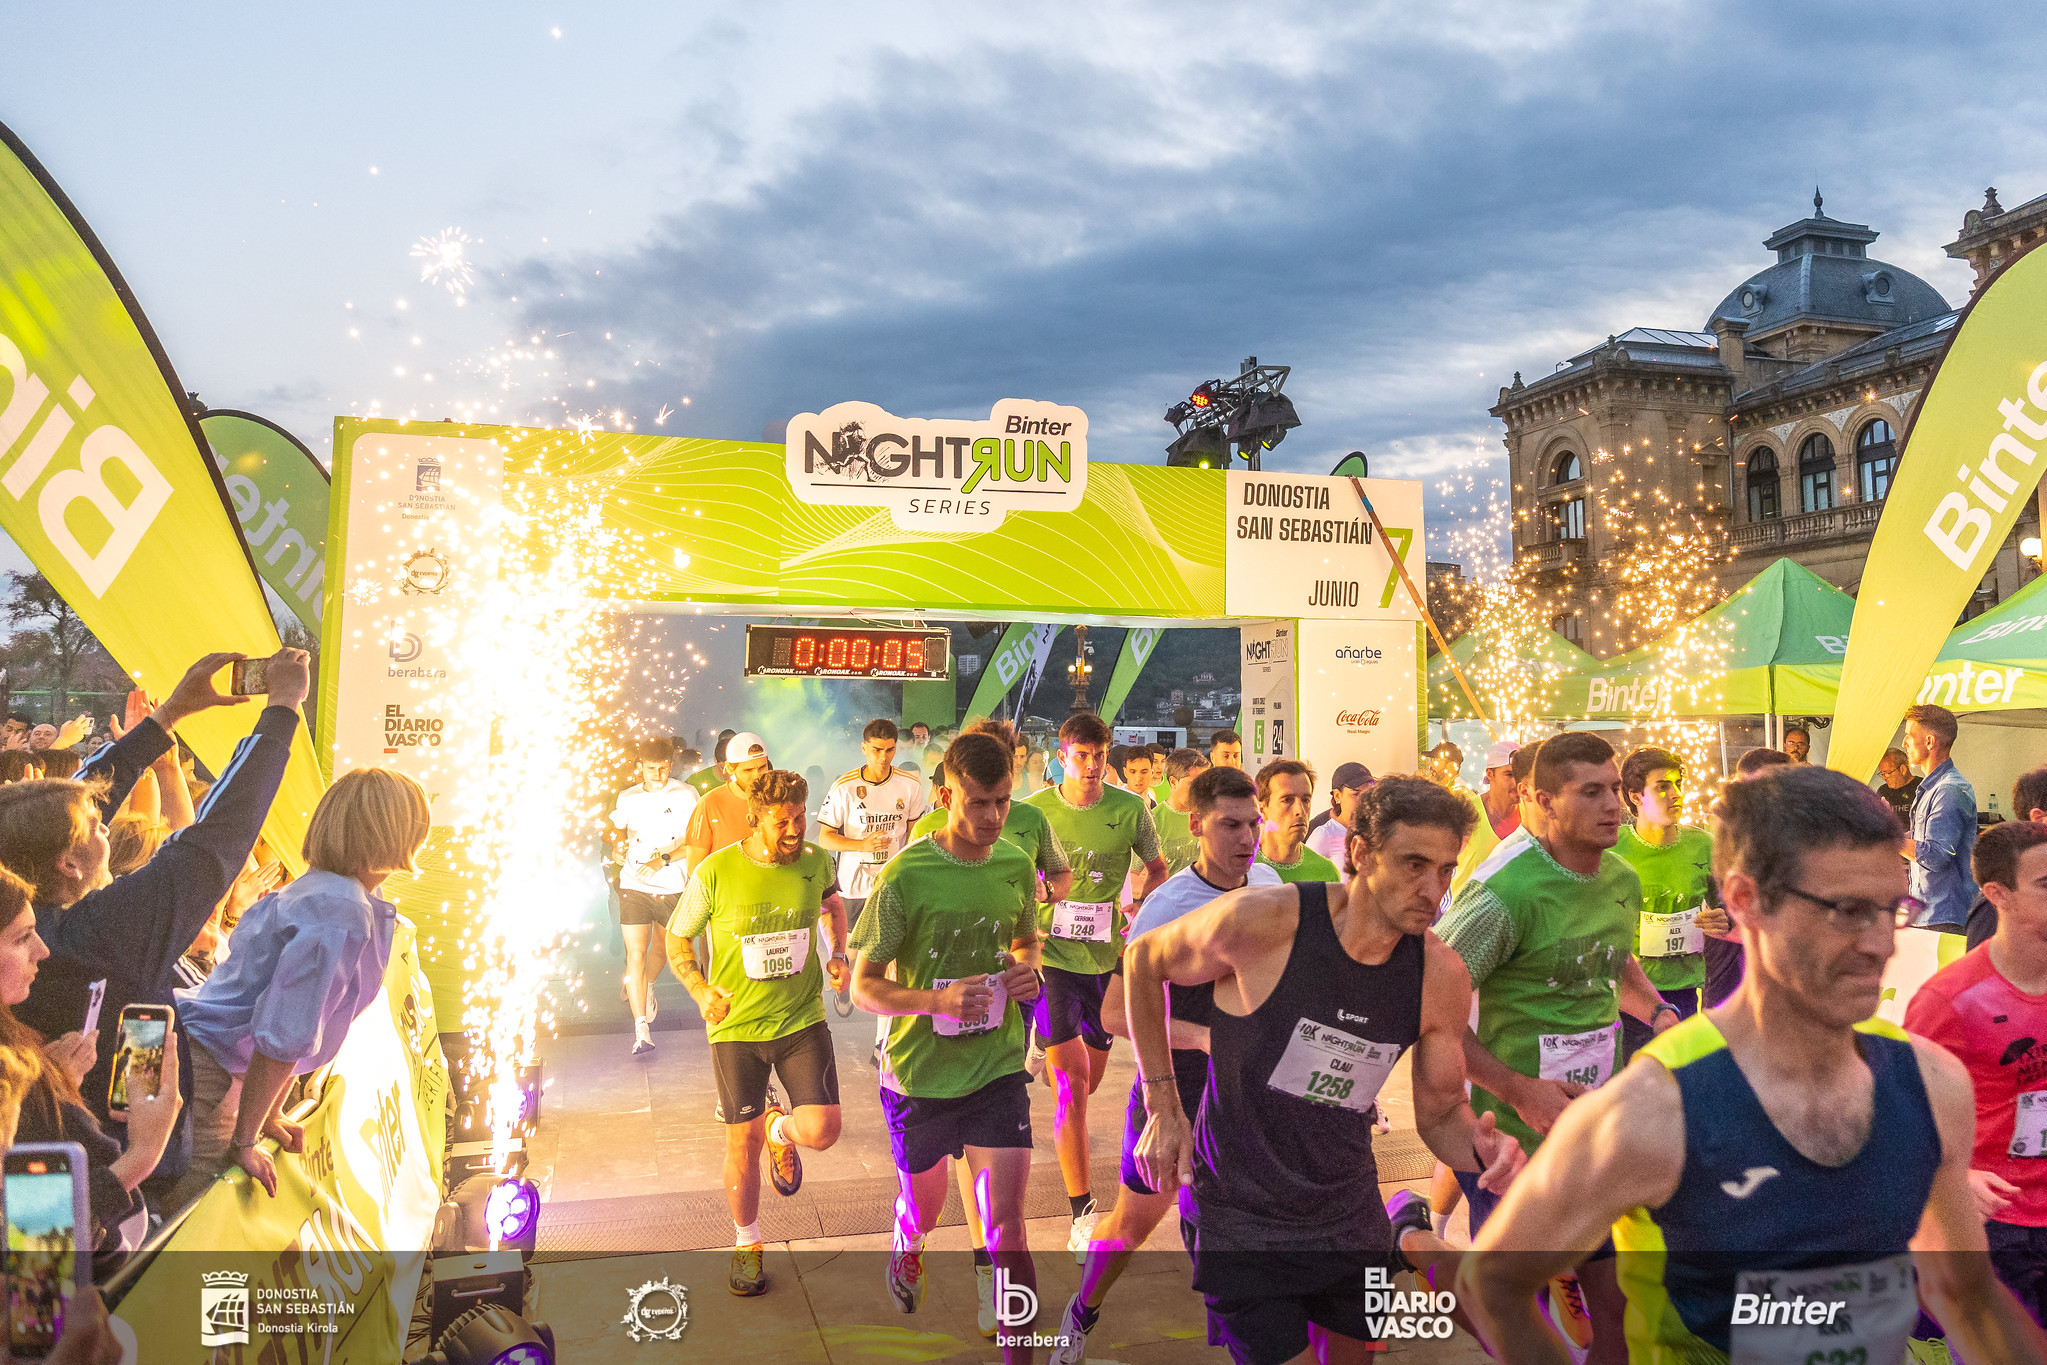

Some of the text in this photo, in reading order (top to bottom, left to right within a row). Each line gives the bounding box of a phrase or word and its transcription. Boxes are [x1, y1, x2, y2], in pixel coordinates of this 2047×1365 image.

[1005, 415, 1071, 436] Binter
[1243, 483, 1330, 510] DONOSTIA
[909, 499, 990, 515] SERIES
[1236, 516, 1373, 545] SAN SEBASTIÁN
[1378, 527, 1413, 608] 7
[1309, 580, 1359, 607] JUNIO
[794, 636, 924, 669] 0:00:05
[1335, 646, 1382, 658] añarbe
[388, 666, 447, 678] berabera
[1916, 662, 2024, 706] inter
[1586, 677, 1671, 713] Binter
[386, 704, 405, 717] EL
[1336, 709, 1381, 726] Coca-Cola
[385, 719, 444, 732] DIARIO
[385, 733, 441, 746] VASCO
[1256, 725, 1262, 750] 5
[1273, 725, 1283, 750] 24
[860, 813, 903, 824] Emirates
[873, 851, 889, 861] 1018
[1070, 924, 1095, 936] 1248
[766, 947, 789, 956] LAURENT
[1665, 937, 1685, 951] 197
[763, 956, 793, 973] 1096
[1299, 1022, 1321, 1041] 10K
[1330, 1058, 1354, 1073] CLAU
[1306, 1070, 1355, 1099] 1258
